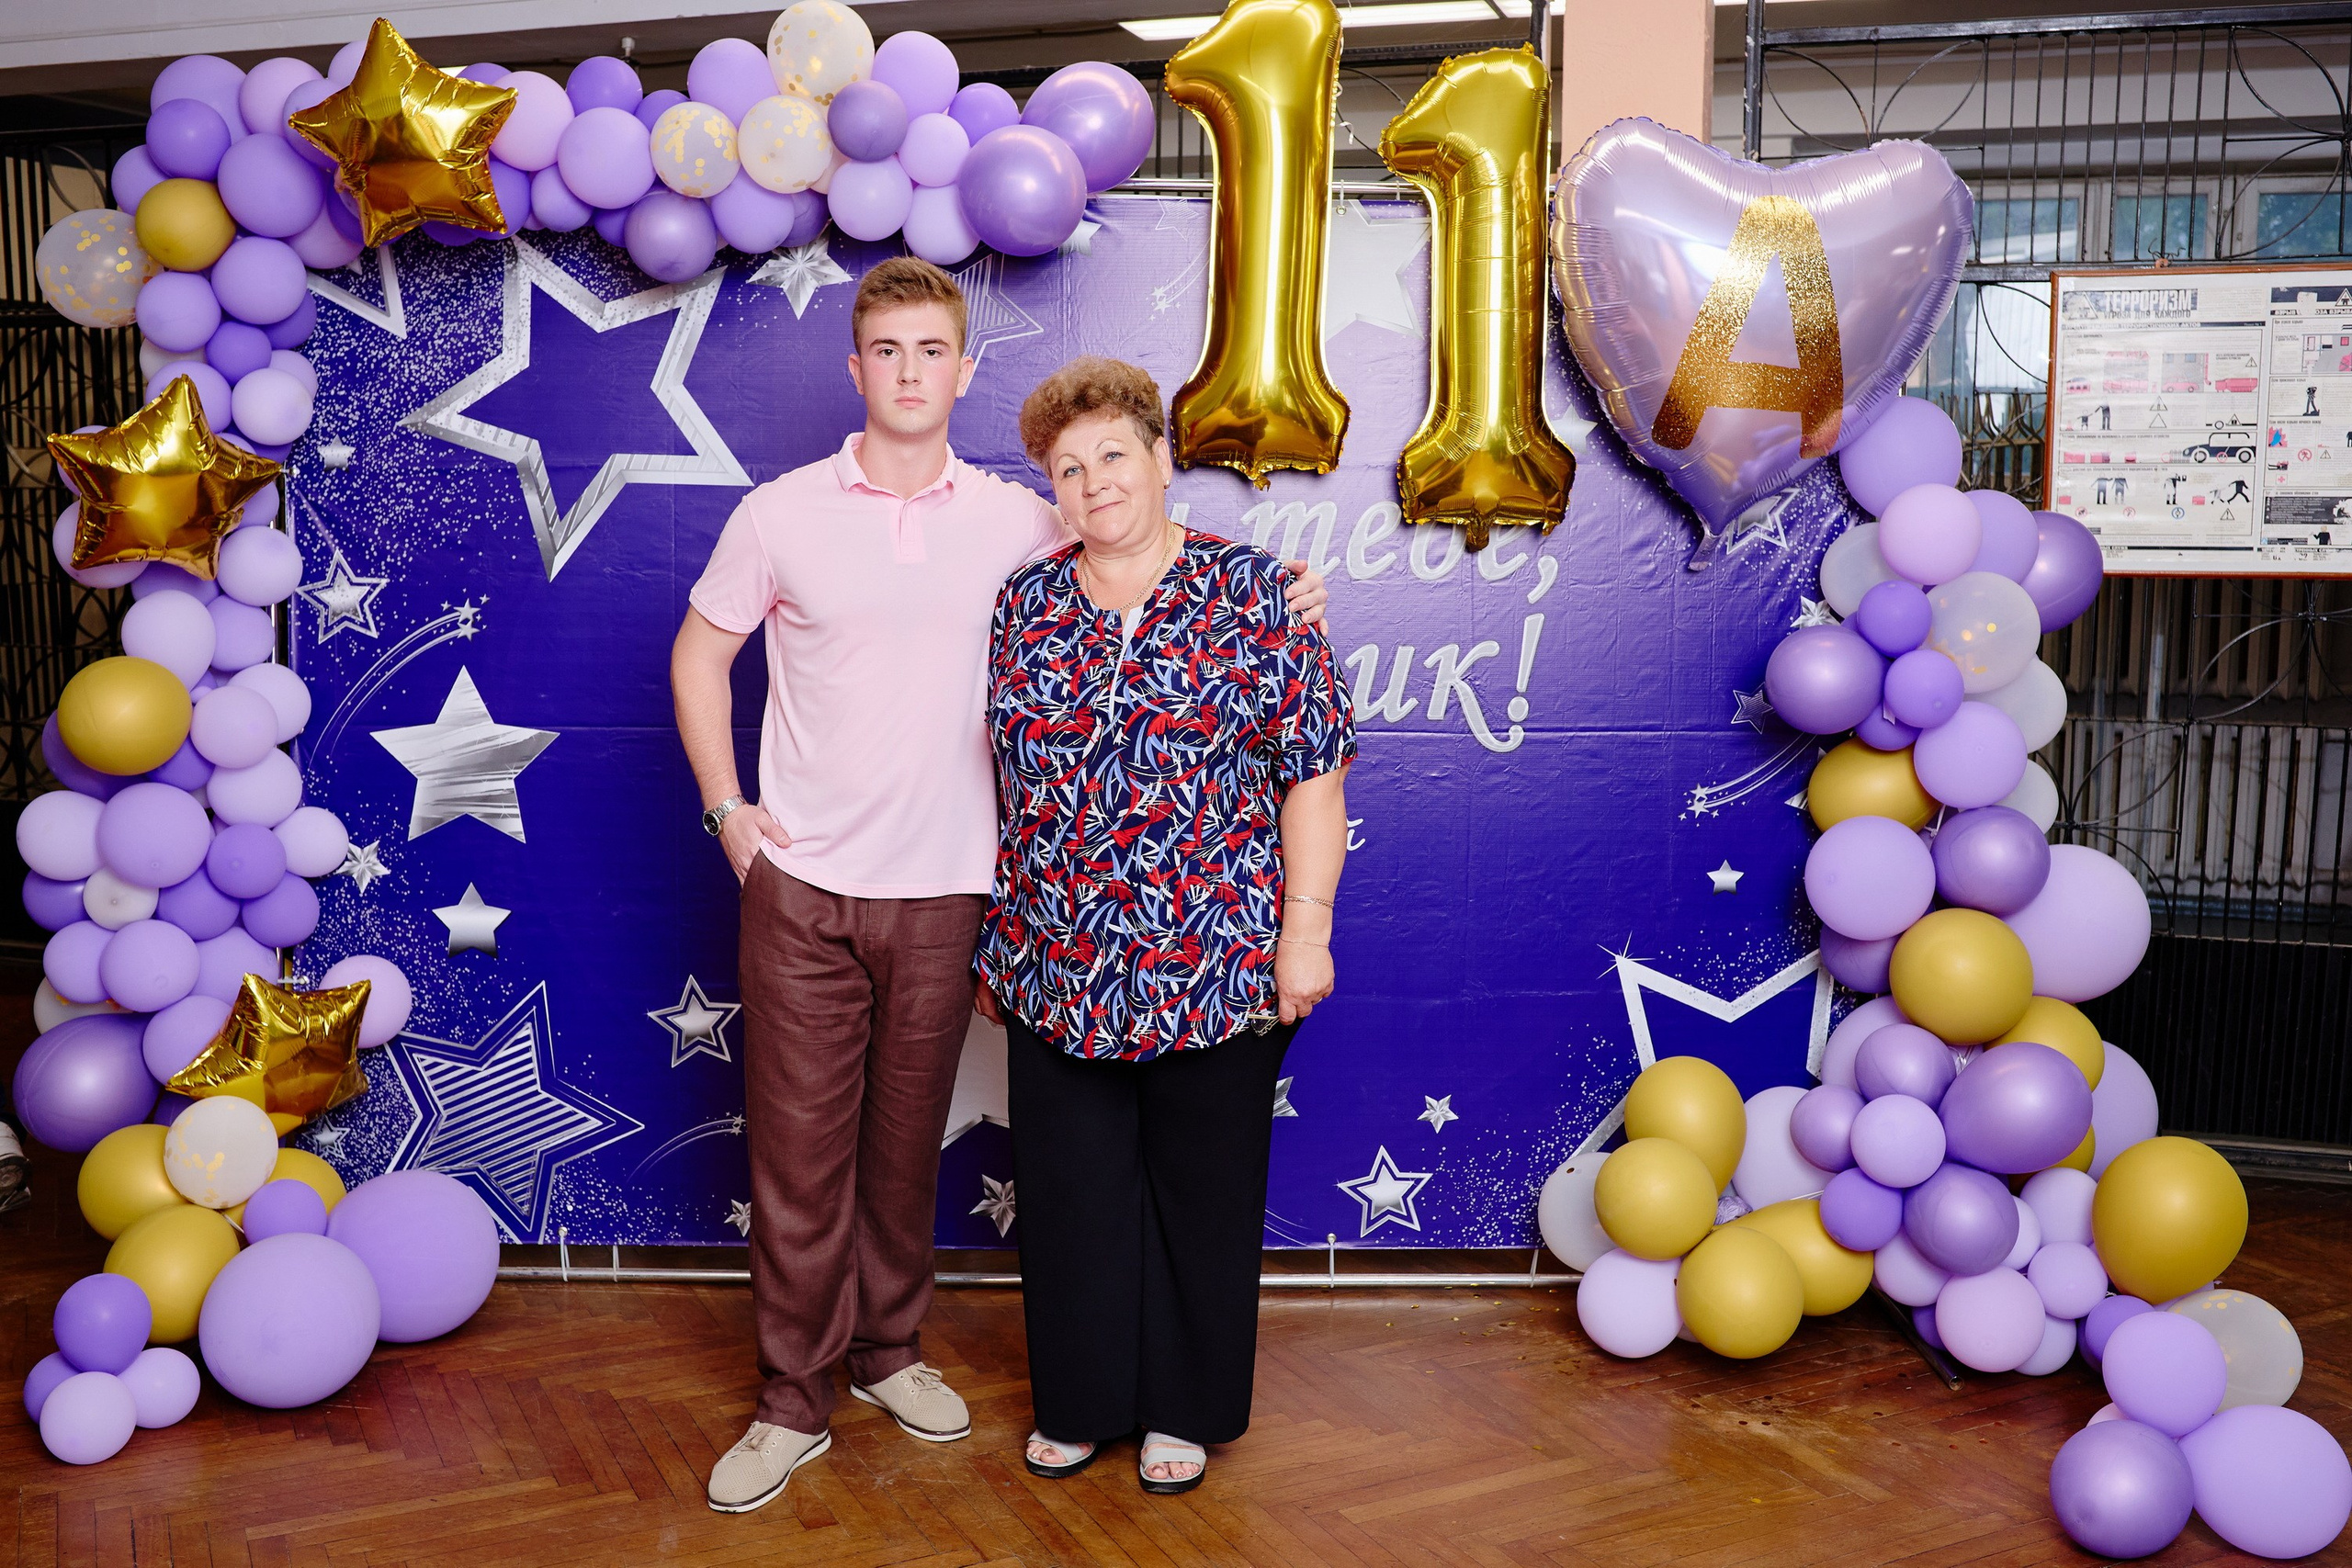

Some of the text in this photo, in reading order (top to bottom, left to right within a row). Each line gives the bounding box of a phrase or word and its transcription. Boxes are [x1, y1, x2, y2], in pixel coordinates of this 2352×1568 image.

[2104, 289, 2192, 311] ТЕРРОРИЗМ
[2104, 310, 2191, 319] УГРОЗА ДЛЯ КАЖДОГО
